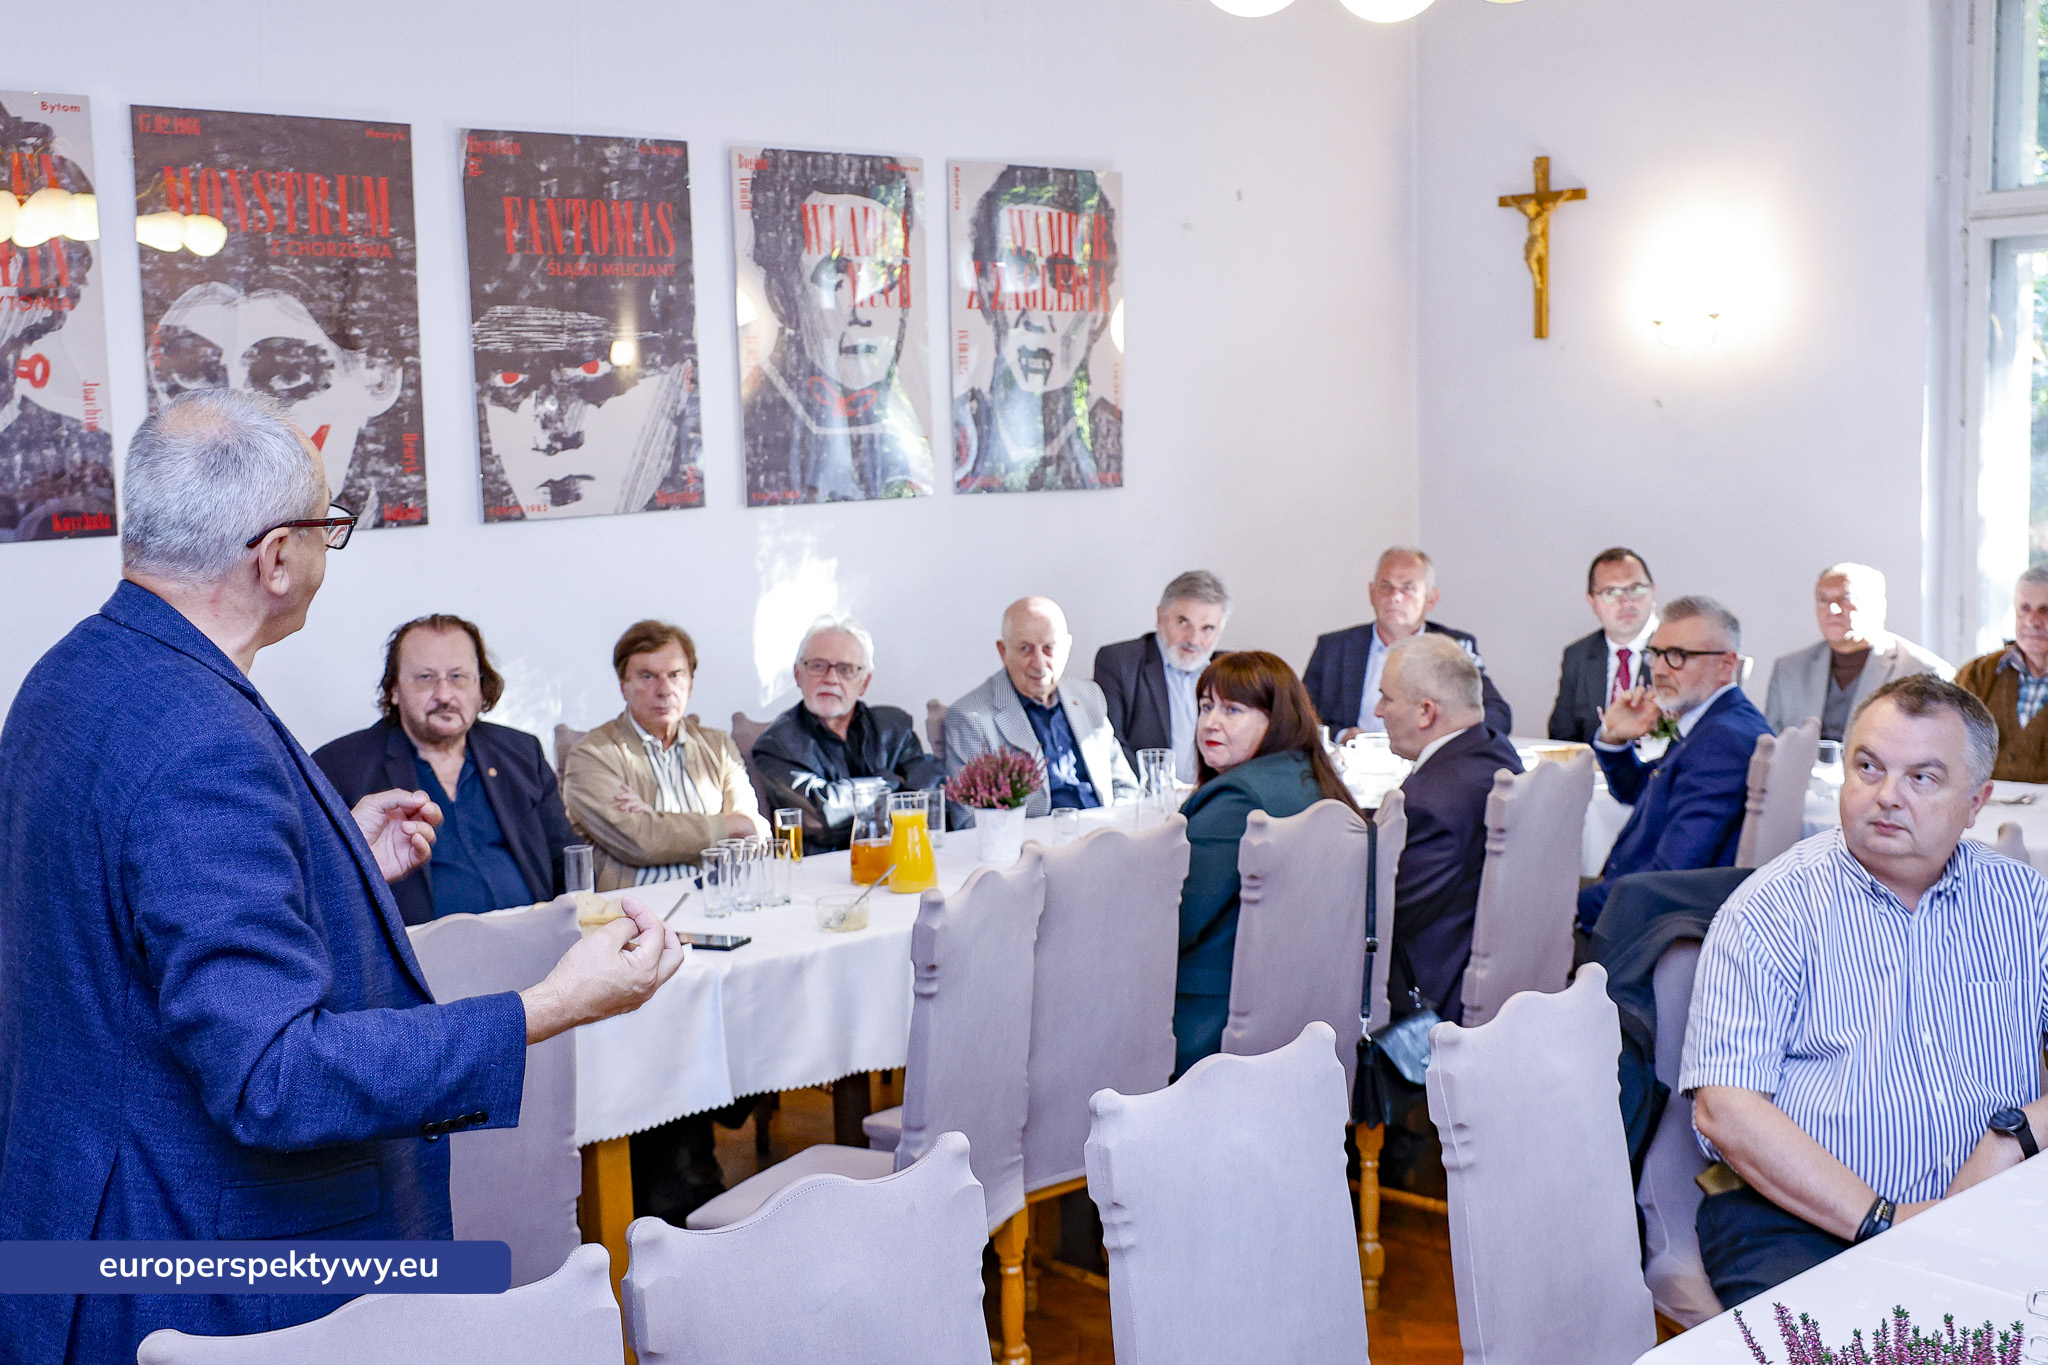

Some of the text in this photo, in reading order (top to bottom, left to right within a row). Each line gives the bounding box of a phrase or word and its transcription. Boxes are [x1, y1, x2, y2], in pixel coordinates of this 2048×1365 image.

[41, 101, 81, 114] Bytom
[162, 165, 391, 237] MONSTRUM
[502, 196, 677, 257] FANTOMAS
[270, 240, 393, 258] Z CHORZOWA
[547, 258, 676, 280] ŚLĄSKI MILICJANT
